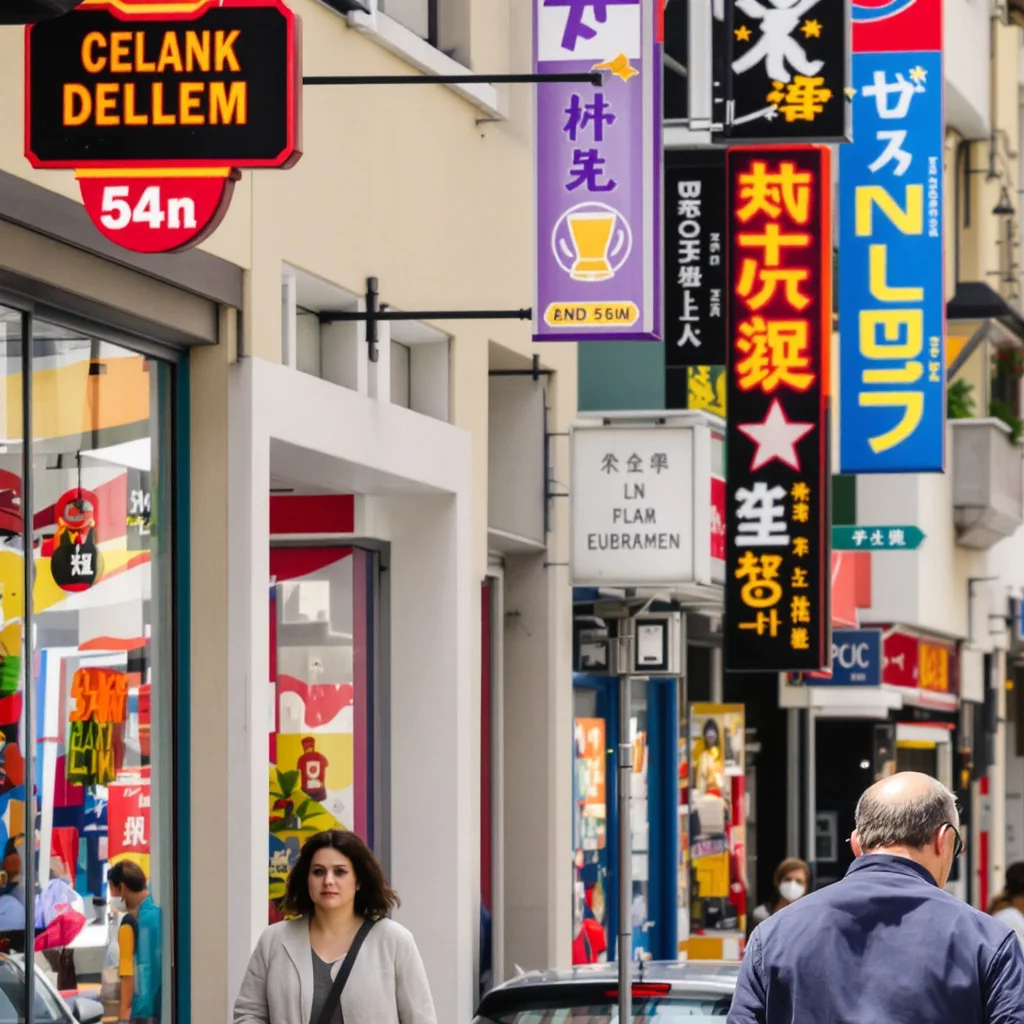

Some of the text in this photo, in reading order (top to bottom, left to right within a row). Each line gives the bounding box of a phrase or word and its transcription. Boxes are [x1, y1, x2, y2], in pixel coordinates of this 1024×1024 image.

[80, 30, 241, 73] CELANK
[62, 81, 247, 126] DELLEM
[100, 186, 198, 230] 54n
